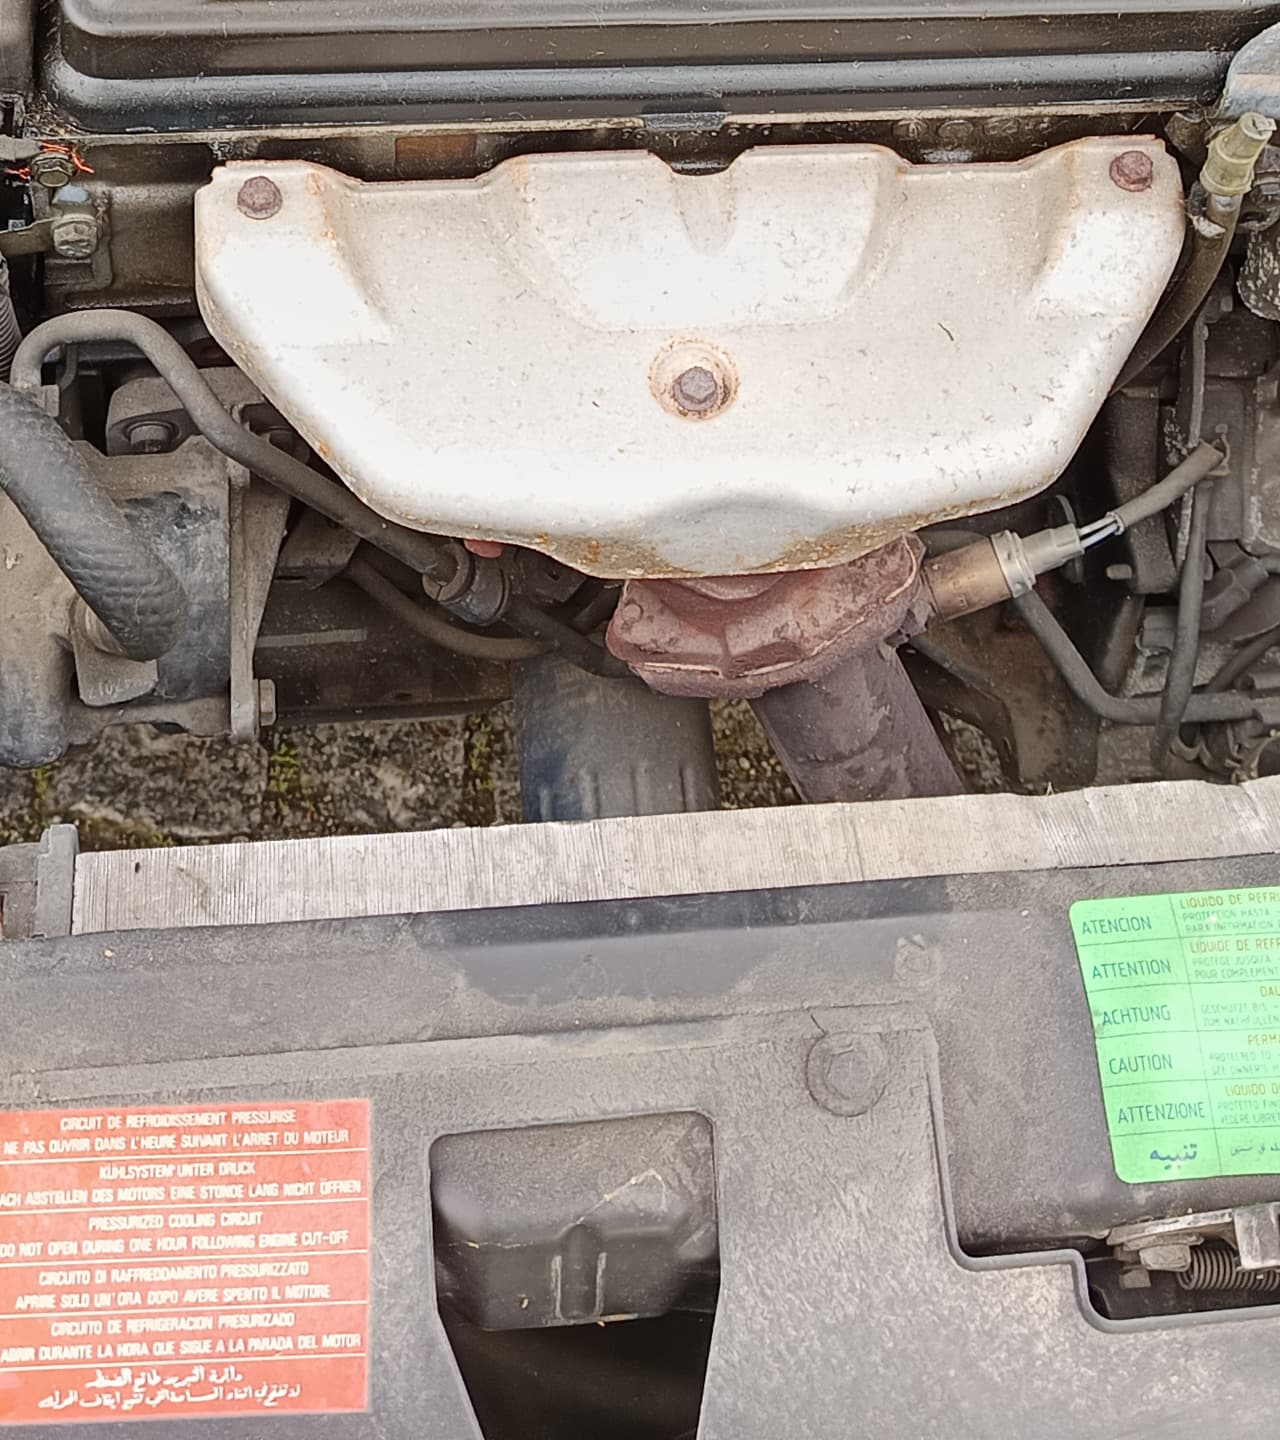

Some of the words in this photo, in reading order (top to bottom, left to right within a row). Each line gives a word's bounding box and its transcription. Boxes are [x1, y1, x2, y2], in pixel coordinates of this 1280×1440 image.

[1228, 894, 1243, 905] DE
[1080, 916, 1152, 934] ATENCION
[1236, 939, 1250, 951] DE
[1091, 959, 1172, 979] ATTENTION
[1101, 1005, 1171, 1025] ACHTUNG
[1108, 1054, 1173, 1074] CAUTION
[1116, 1102, 1206, 1124] ATTENZIONE
